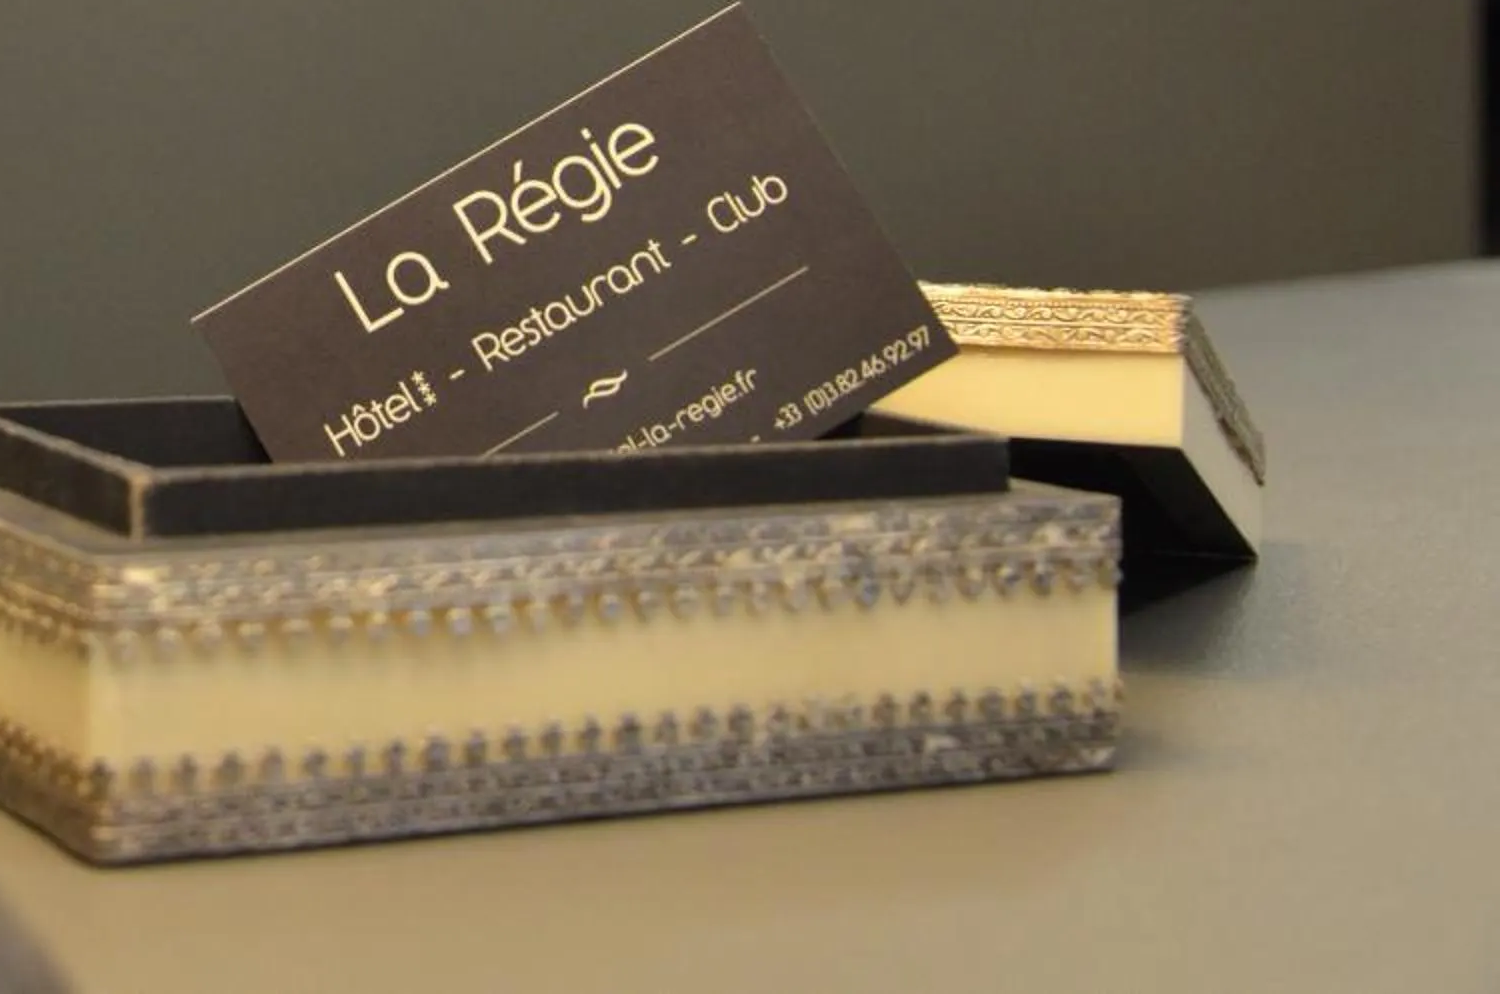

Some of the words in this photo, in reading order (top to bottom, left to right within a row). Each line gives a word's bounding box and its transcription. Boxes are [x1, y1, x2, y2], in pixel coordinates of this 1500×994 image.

[334, 251, 450, 333] La
[452, 122, 659, 265] Régie
[471, 238, 671, 372] Restaurant
[706, 173, 788, 233] Club
[609, 368, 757, 455] el-la-regie.fr
[774, 402, 802, 430] +33
